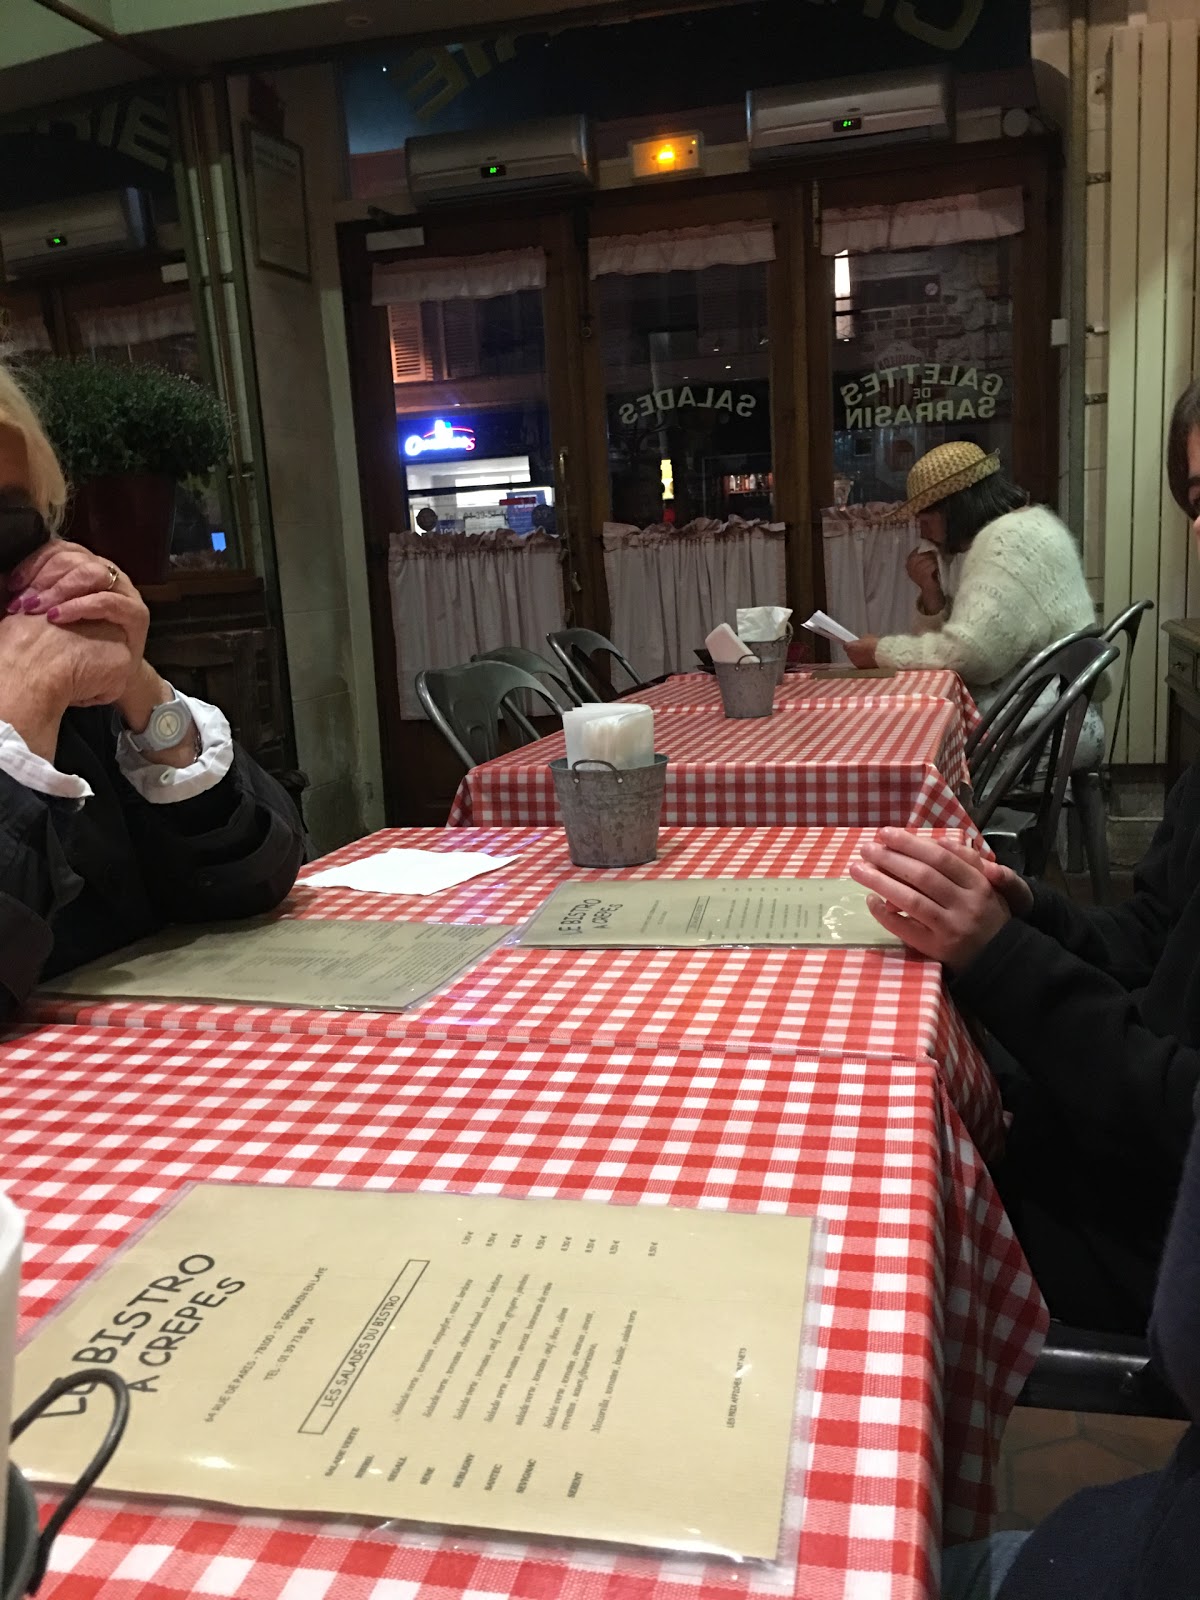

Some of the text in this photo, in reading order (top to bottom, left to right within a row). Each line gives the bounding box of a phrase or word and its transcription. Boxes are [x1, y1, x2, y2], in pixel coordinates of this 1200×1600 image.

[560, 899, 602, 926] BISTRO
[592, 904, 624, 924] CREPES
[72, 1254, 215, 1364] BISTRO
[126, 1277, 246, 1392] A CREPES
[211, 1395, 231, 1411] RUE
[224, 1384, 240, 1394] DE
[232, 1360, 256, 1383] PARIS
[254, 1334, 275, 1355] 78100
[273, 1321, 285, 1330] ST
[281, 1292, 309, 1320] GERMAIN
[303, 1282, 316, 1292] EN
[263, 1368, 281, 1380] TEL
[283, 1344, 296, 1353] 39
[290, 1334, 303, 1343] 73
[320, 1294, 401, 1408] LES SALADES DU BISTRO
[341, 1427, 360, 1449] VERTE
